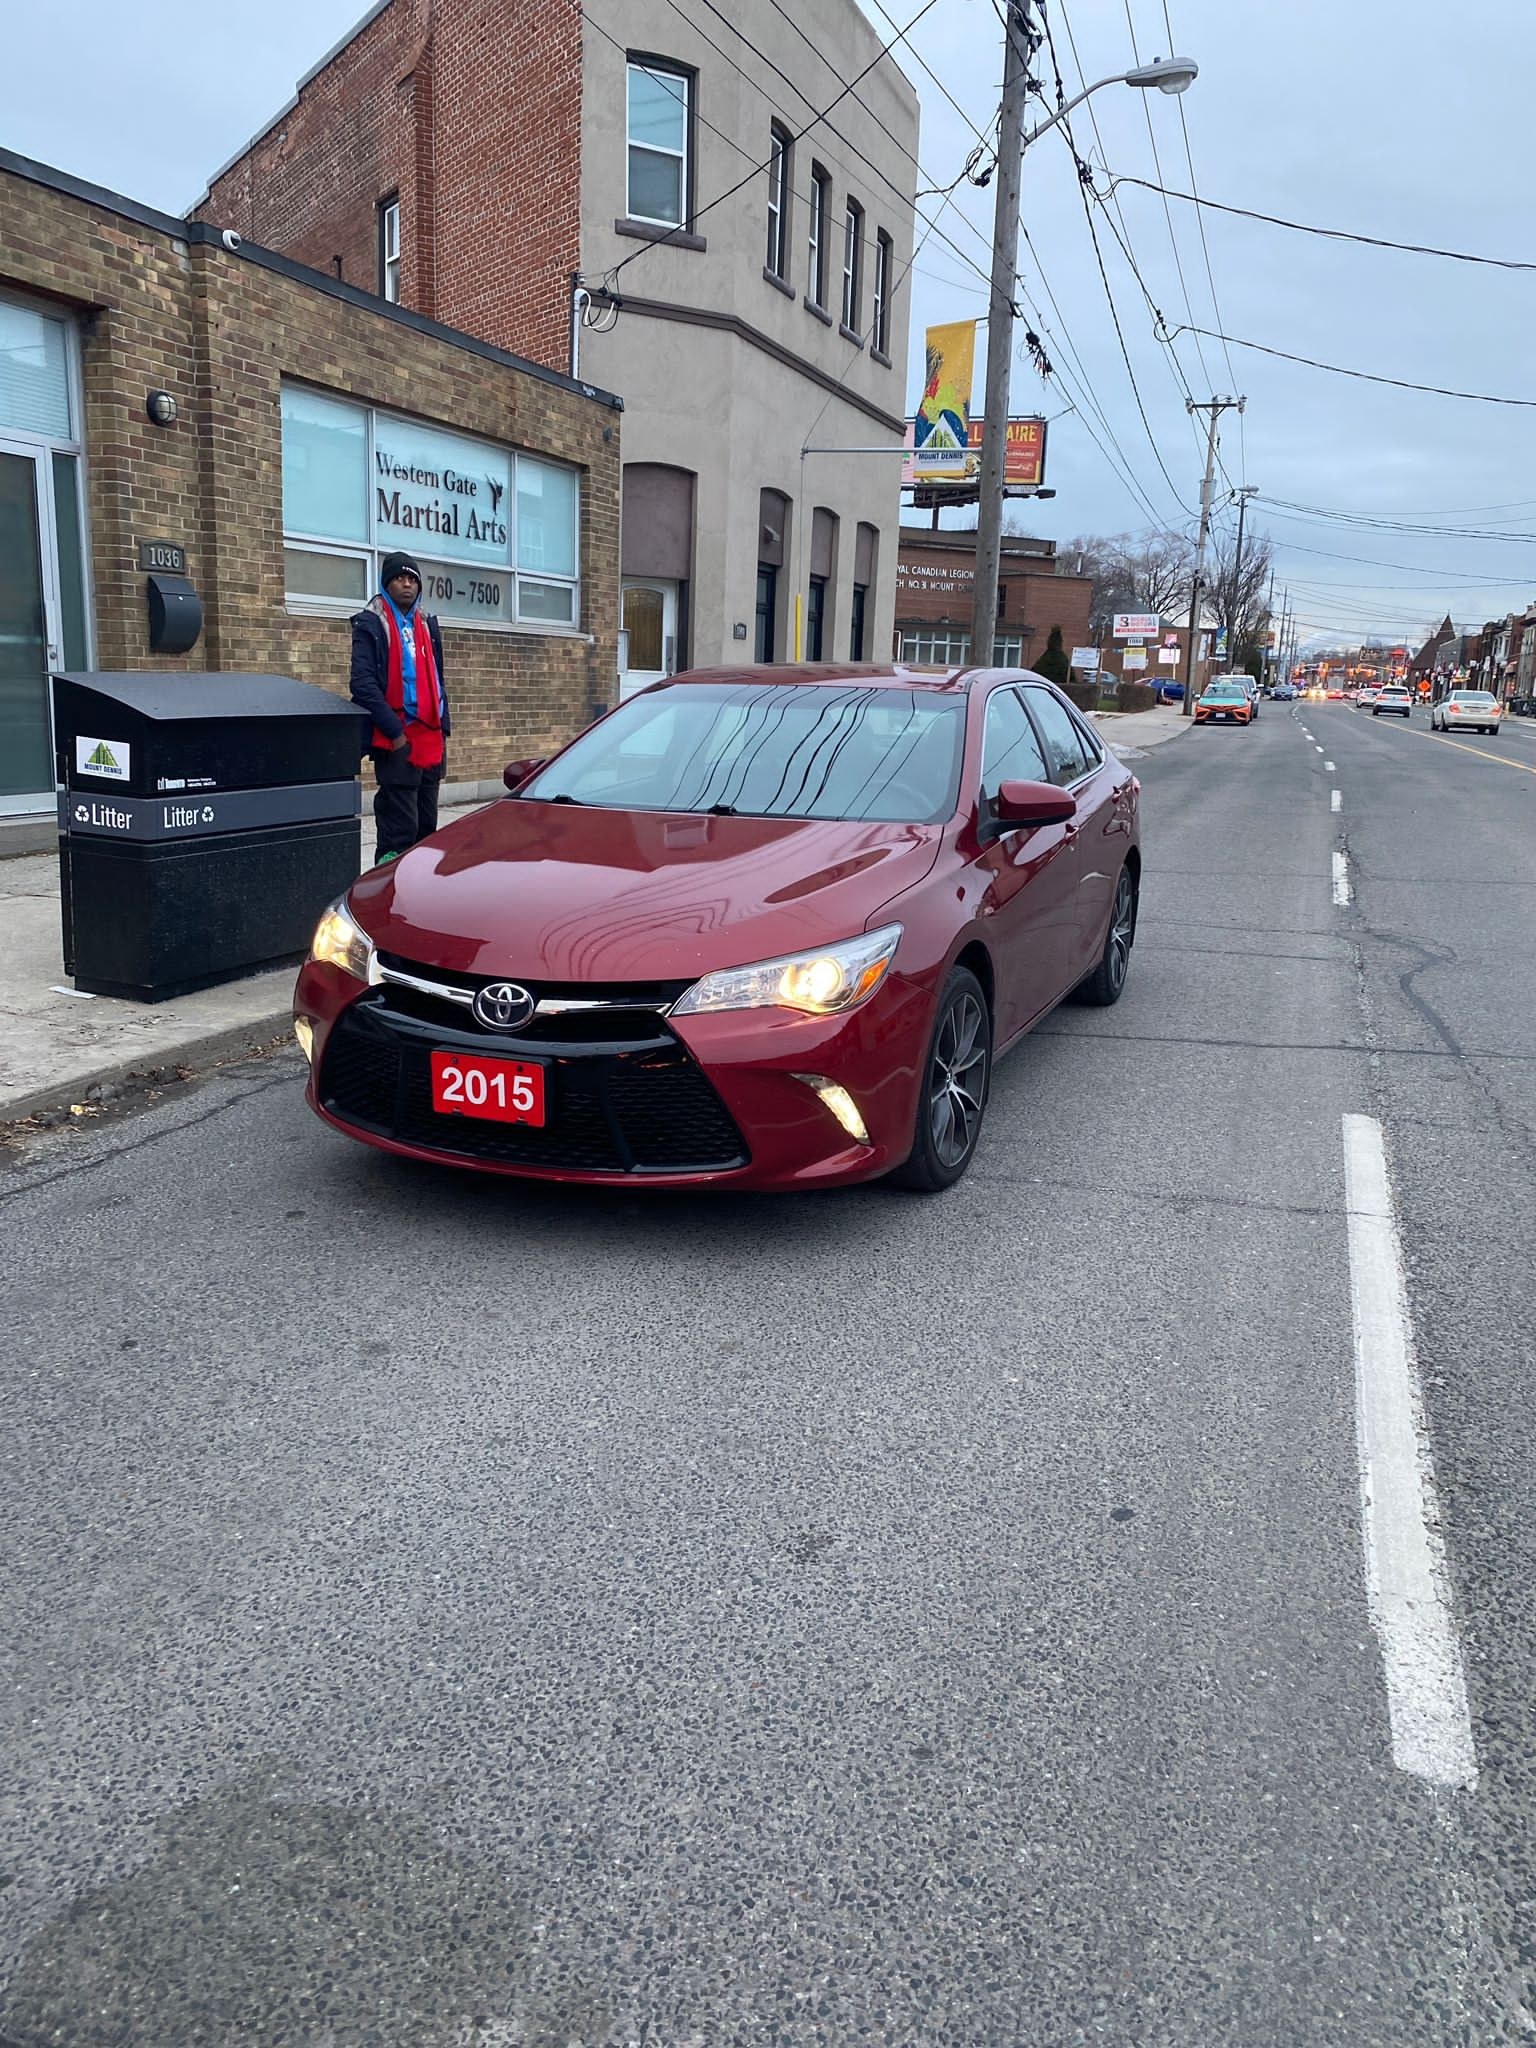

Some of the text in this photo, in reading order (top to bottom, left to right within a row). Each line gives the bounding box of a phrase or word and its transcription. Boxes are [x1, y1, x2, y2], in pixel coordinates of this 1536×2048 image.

[918, 451, 963, 461] MOUNT DENNIS
[375, 451, 477, 497] Western Gate
[376, 487, 507, 545] Martial Arts
[149, 547, 180, 568] 1036
[911, 566, 947, 578] CANADIAN
[949, 569, 975, 580] LEGION
[92, 803, 133, 830] Litter
[163, 806, 200, 829] Litter
[441, 1066, 534, 1111] 2015
